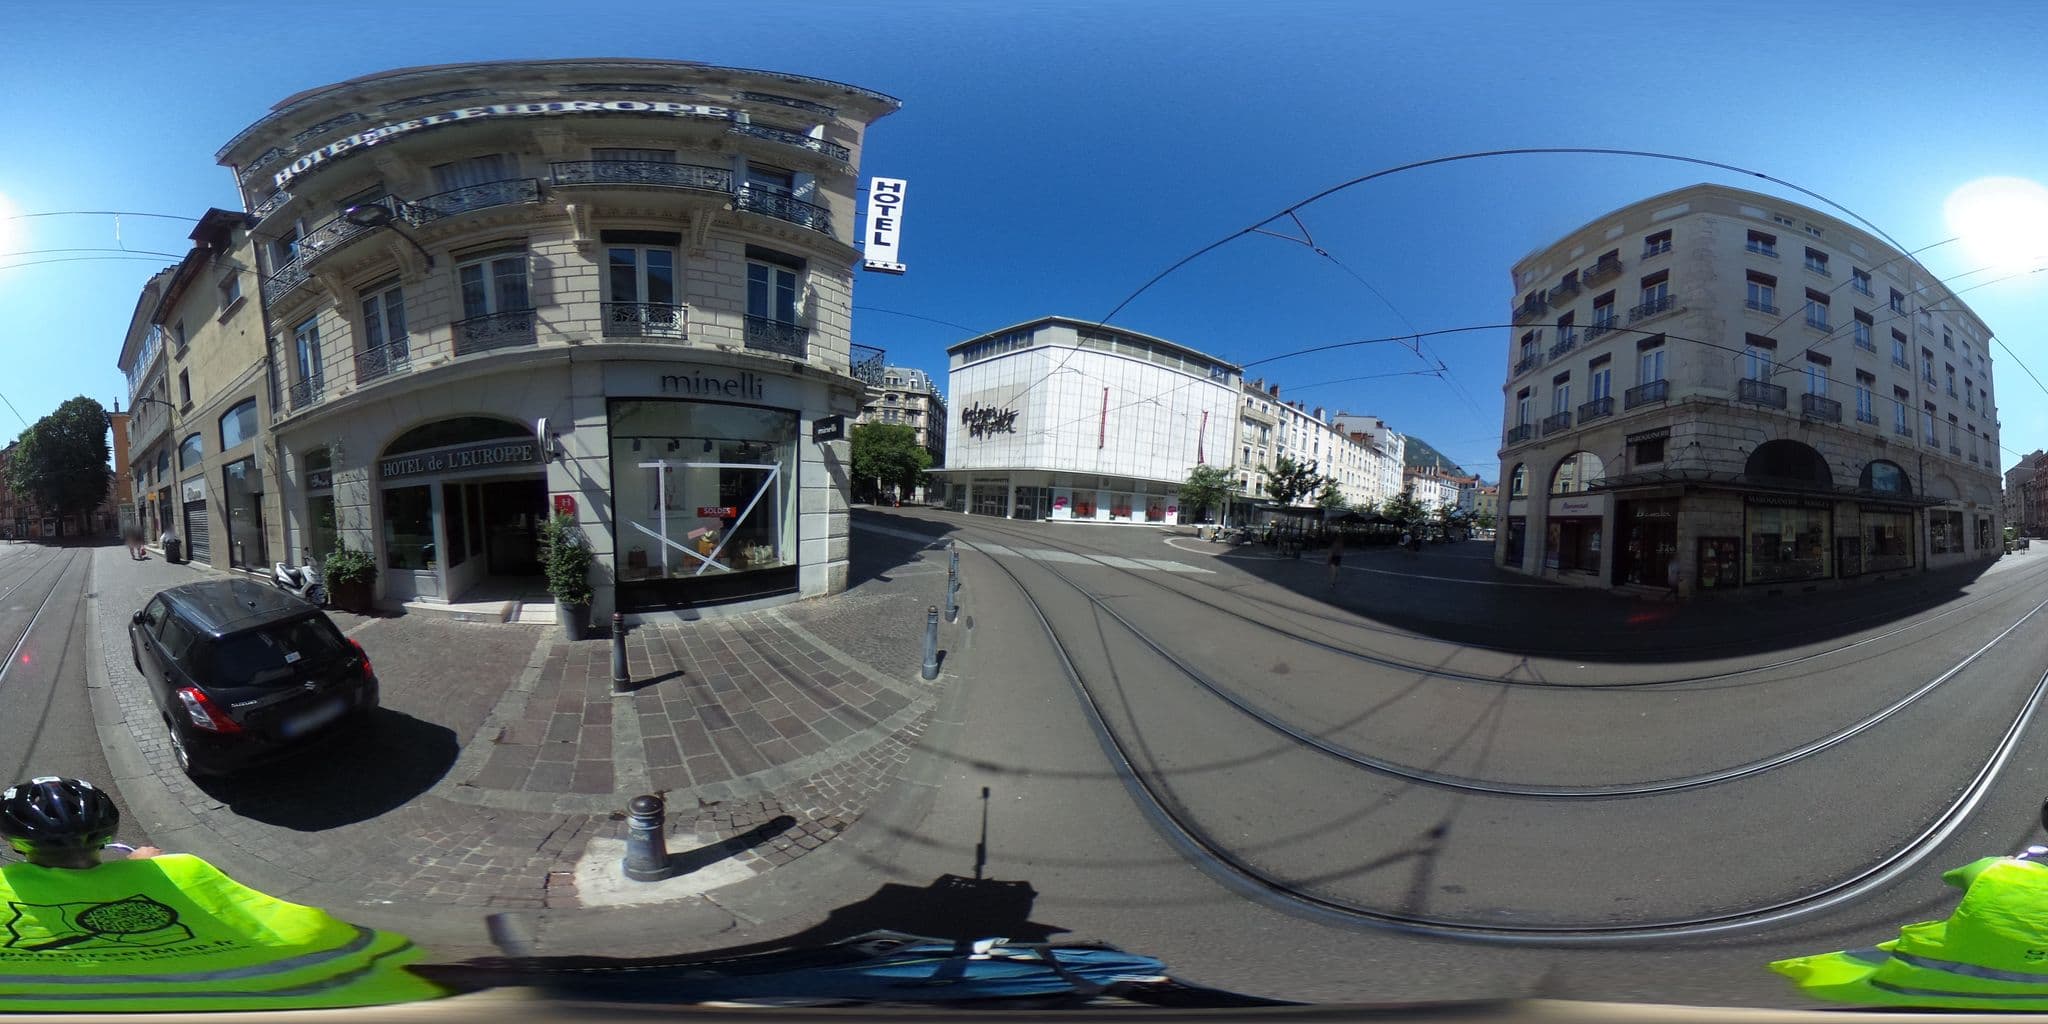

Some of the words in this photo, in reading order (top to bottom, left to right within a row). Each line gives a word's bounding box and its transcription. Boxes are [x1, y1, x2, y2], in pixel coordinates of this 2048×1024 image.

[873, 181, 901, 246] HOTEL
[662, 370, 762, 400] minelli
[384, 458, 424, 477] HOTEL
[428, 455, 443, 471] de
